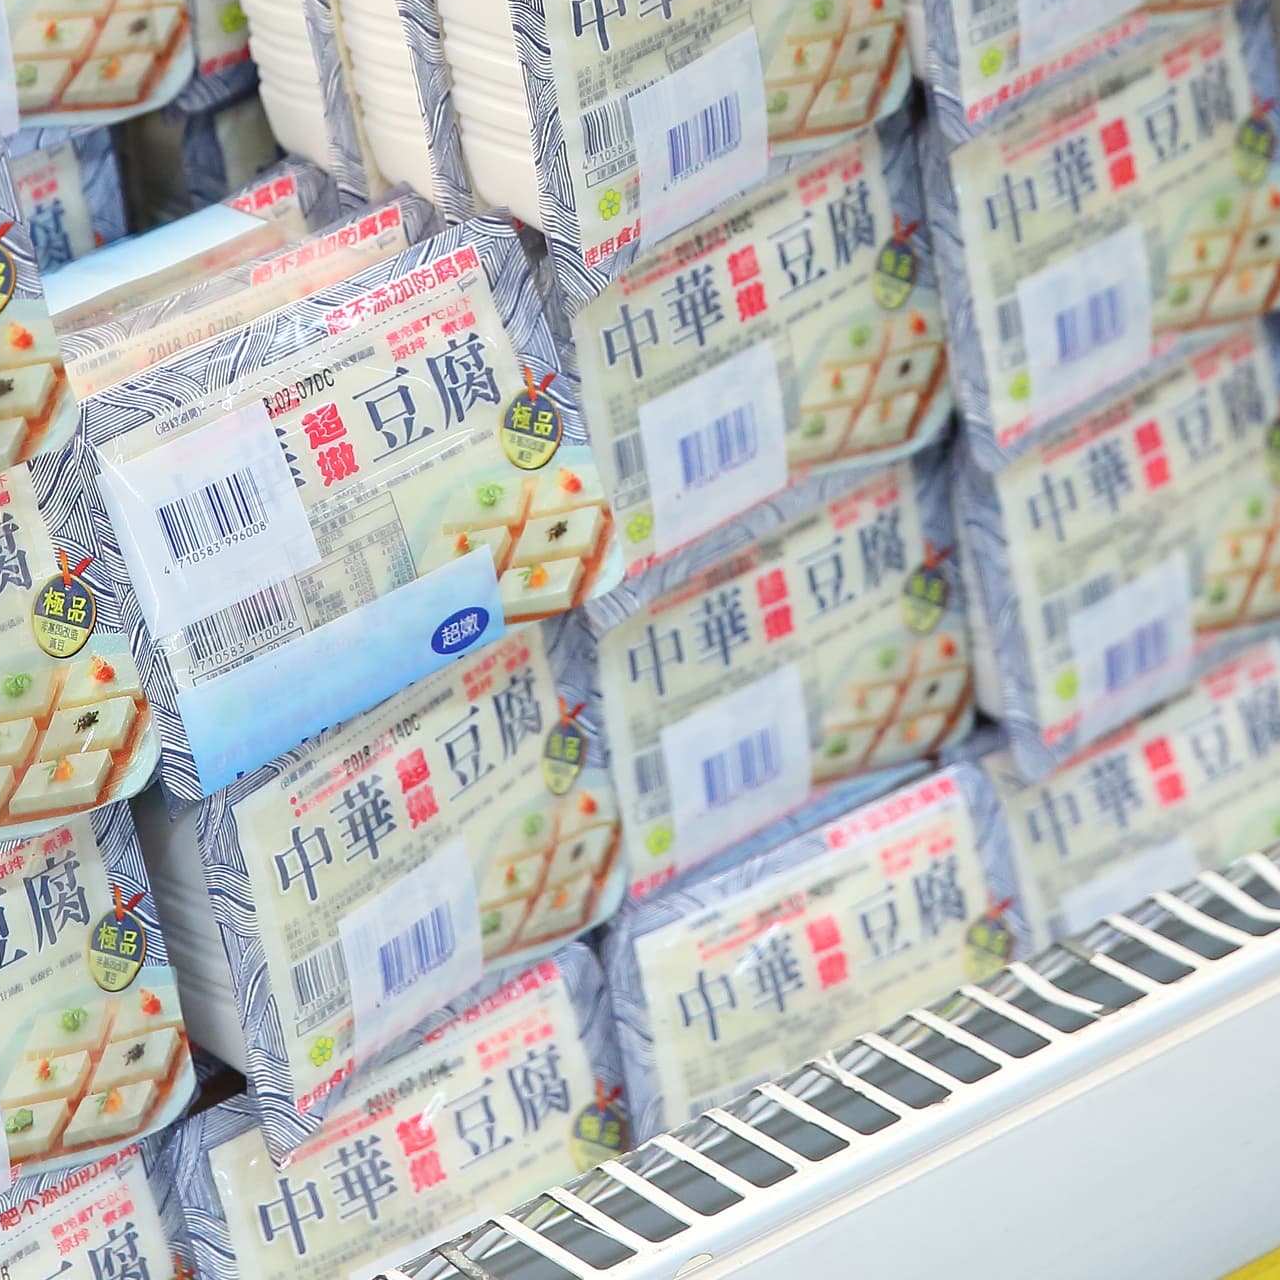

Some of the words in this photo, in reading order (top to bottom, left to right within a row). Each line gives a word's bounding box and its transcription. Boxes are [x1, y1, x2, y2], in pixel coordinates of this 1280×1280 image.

[589, 140, 632, 165] 710583
[984, 135, 1096, 242] 中華
[323, 245, 480, 336] 絕不添加防腐劑
[601, 267, 726, 383] 中華
[767, 176, 877, 301] 豆腐
[300, 402, 361, 487] 超嫩
[351, 331, 501, 464] 豆腐
[510, 403, 554, 440] 極品
[176, 542, 222, 569] 710583
[223, 520, 268, 549] 996008
[42, 584, 86, 624] 極品
[197, 643, 246, 670] 710583
[249, 618, 295, 646] 110046
[441, 613, 480, 648] 超嫩
[627, 584, 751, 695] 中華
[804, 507, 909, 615] 豆腐
[275, 774, 397, 901] 中華
[435, 667, 542, 802] 豆腐
[98, 925, 137, 955] 極品
[676, 930, 808, 1043] 中華
[857, 851, 970, 962] 豆腐
[256, 1135, 398, 1255] 中華
[444, 1044, 571, 1171] 豆腐
